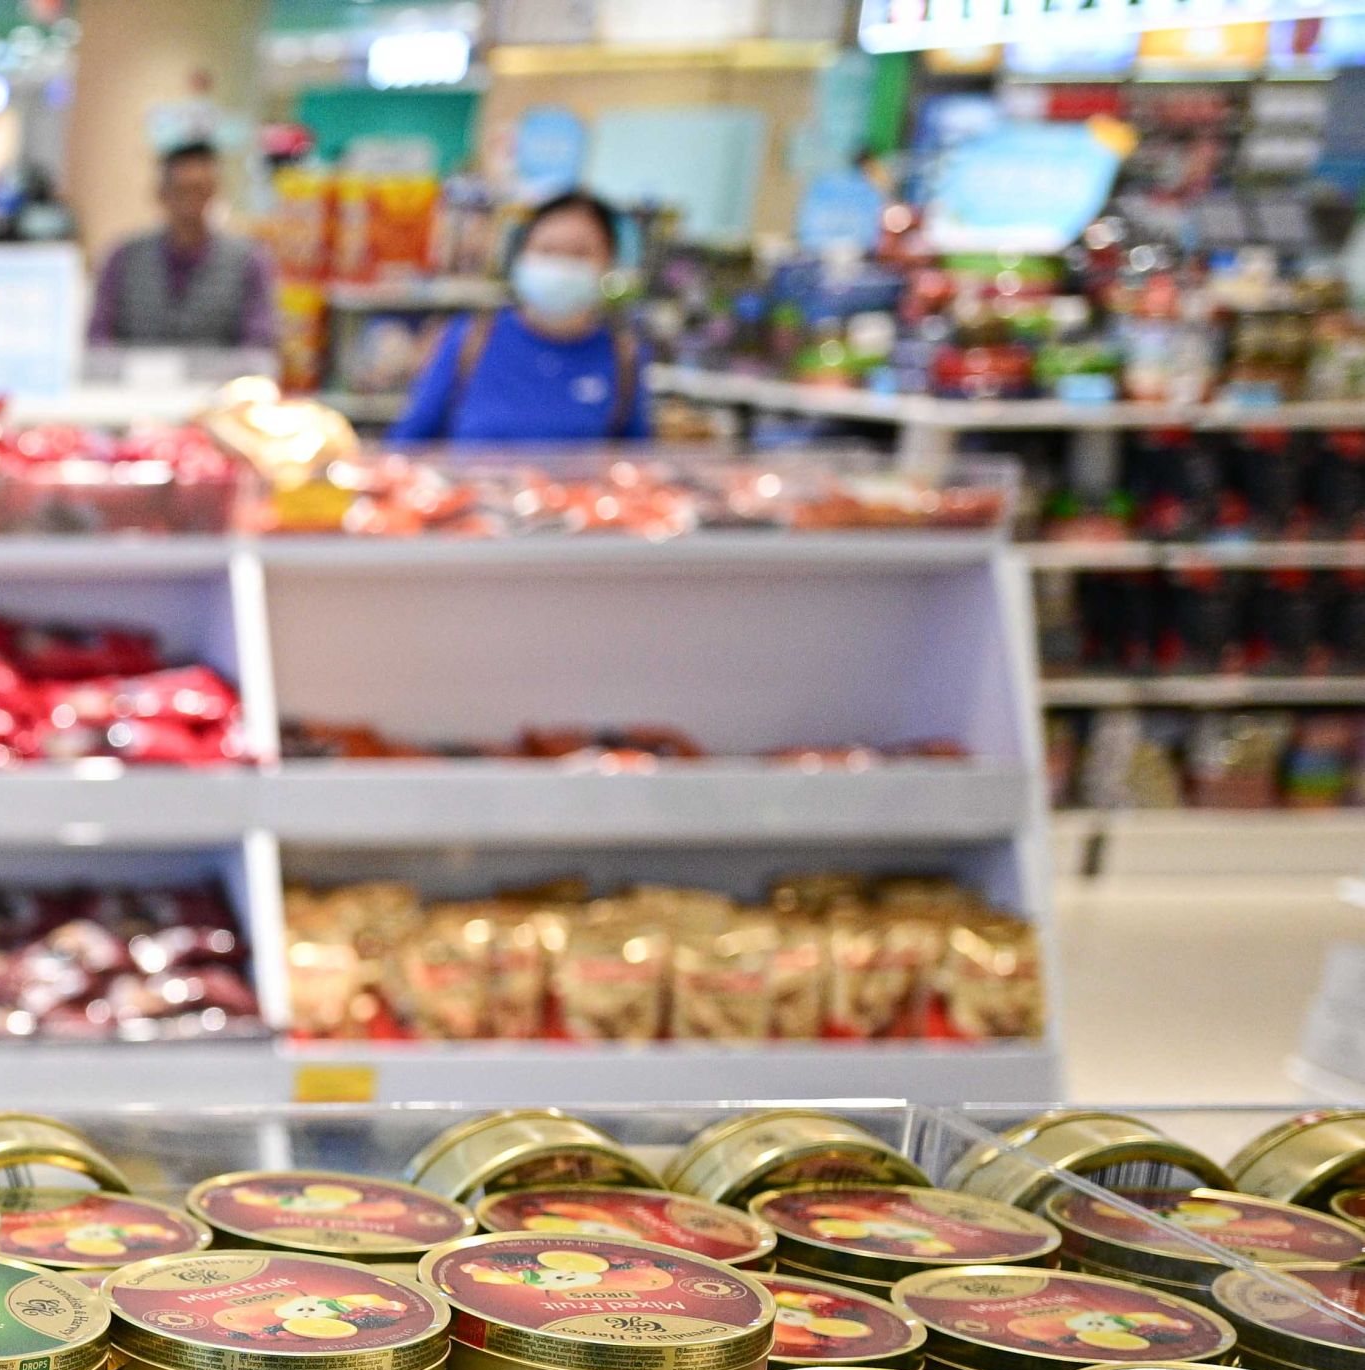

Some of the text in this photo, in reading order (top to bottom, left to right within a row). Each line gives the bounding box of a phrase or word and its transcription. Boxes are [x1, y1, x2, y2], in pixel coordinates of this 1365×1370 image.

[179, 1275, 297, 1305] Mixed Fruit
[570, 1291, 632, 1300] DROPS
[233, 1292, 285, 1306] DROPS
[540, 1300, 685, 1313] Mixed Fruit
